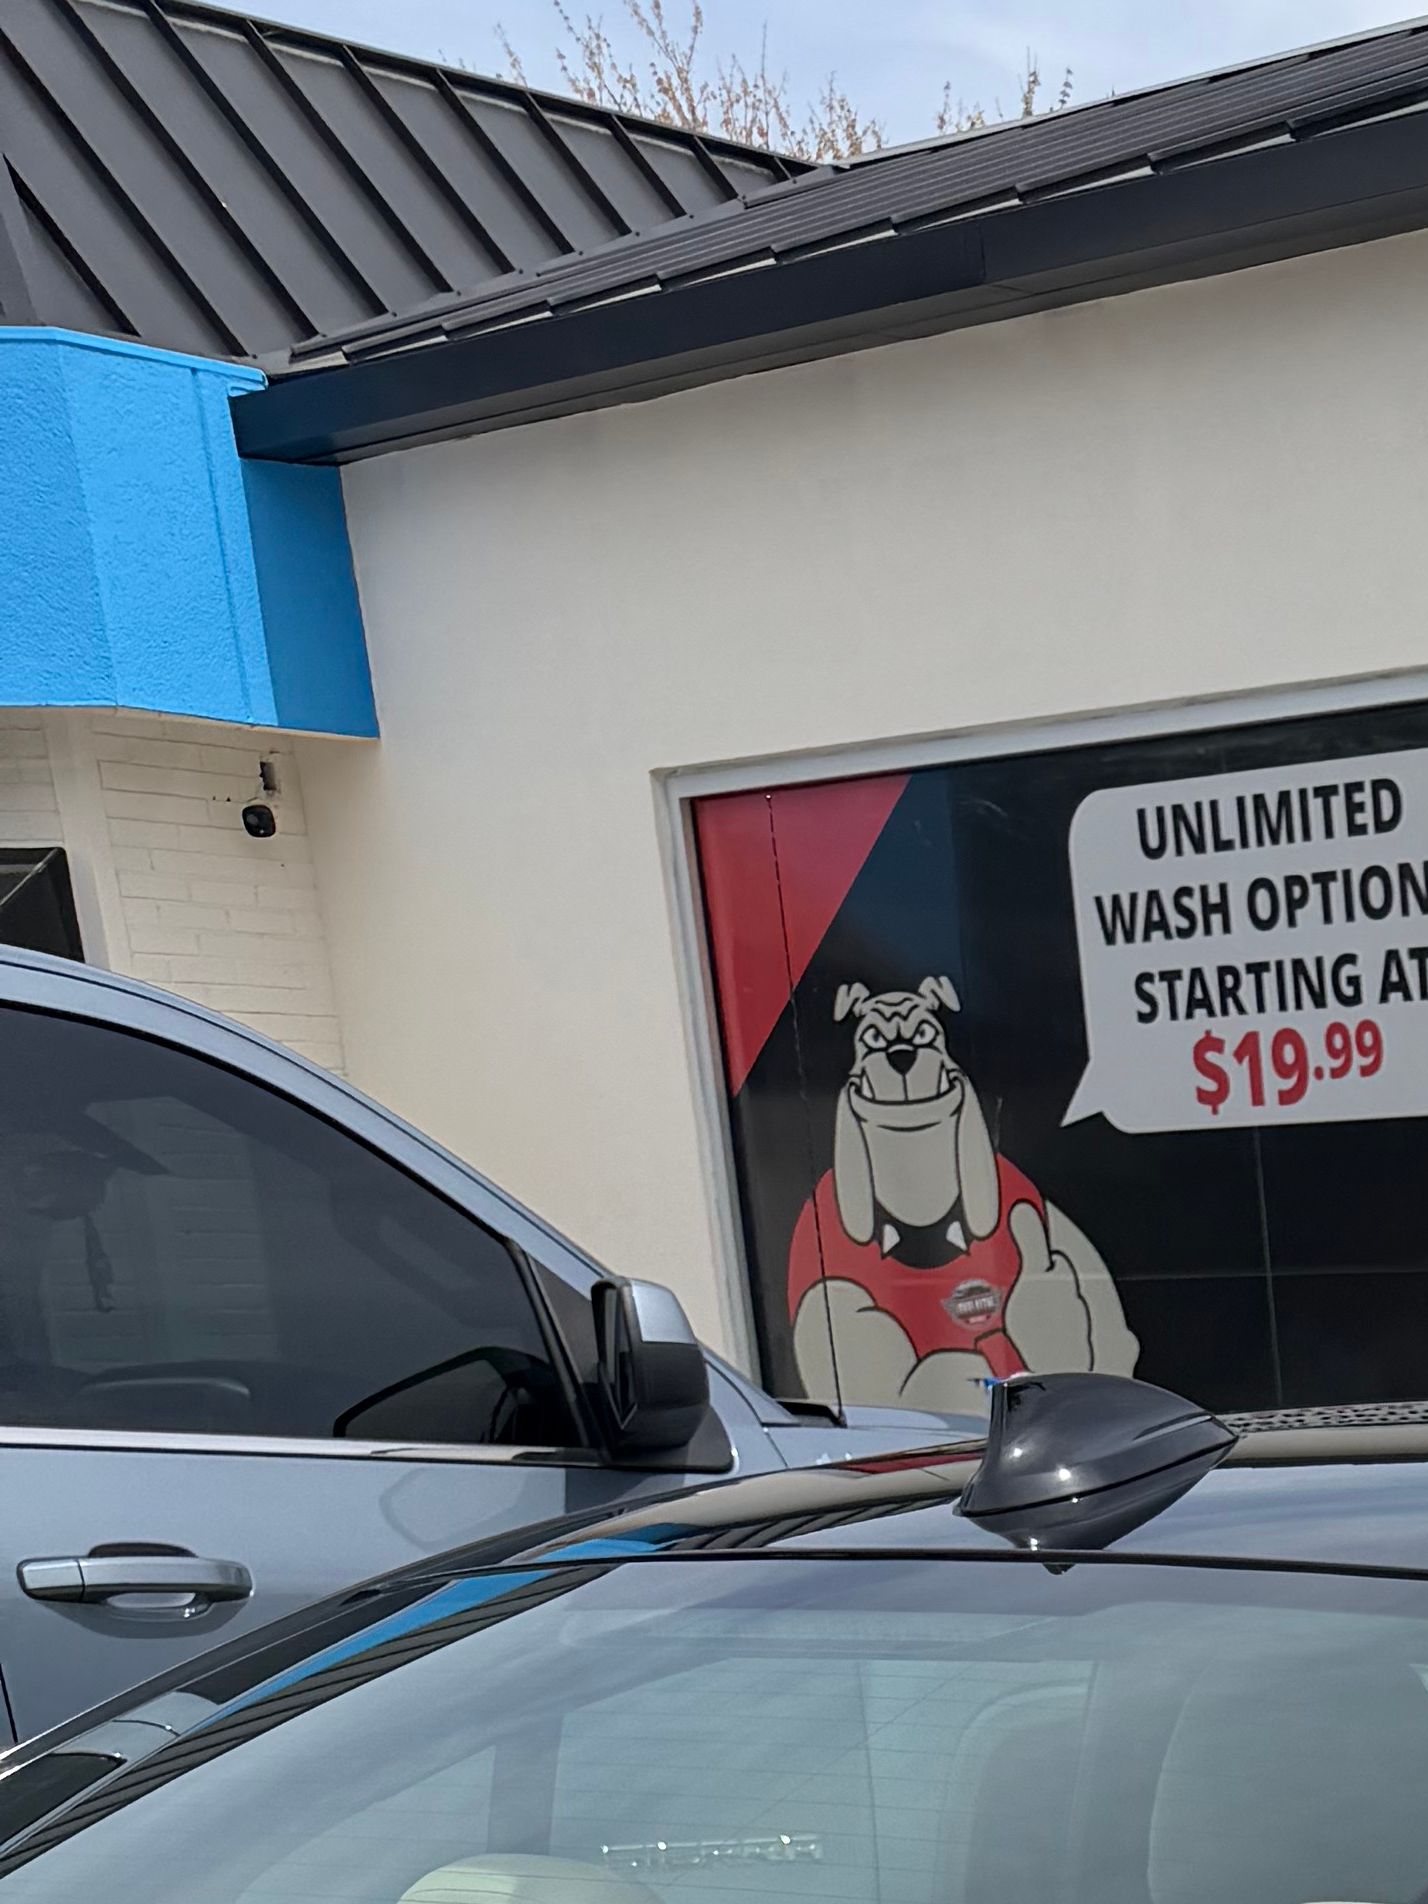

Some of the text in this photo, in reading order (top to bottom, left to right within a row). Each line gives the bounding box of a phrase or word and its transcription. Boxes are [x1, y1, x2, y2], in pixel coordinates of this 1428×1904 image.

[1136, 778, 1403, 860] UNLIMITED
[1093, 882, 1232, 946] WASH
[1134, 953, 1363, 1024] STARTING
[1192, 1018, 1384, 1116] $19.99
